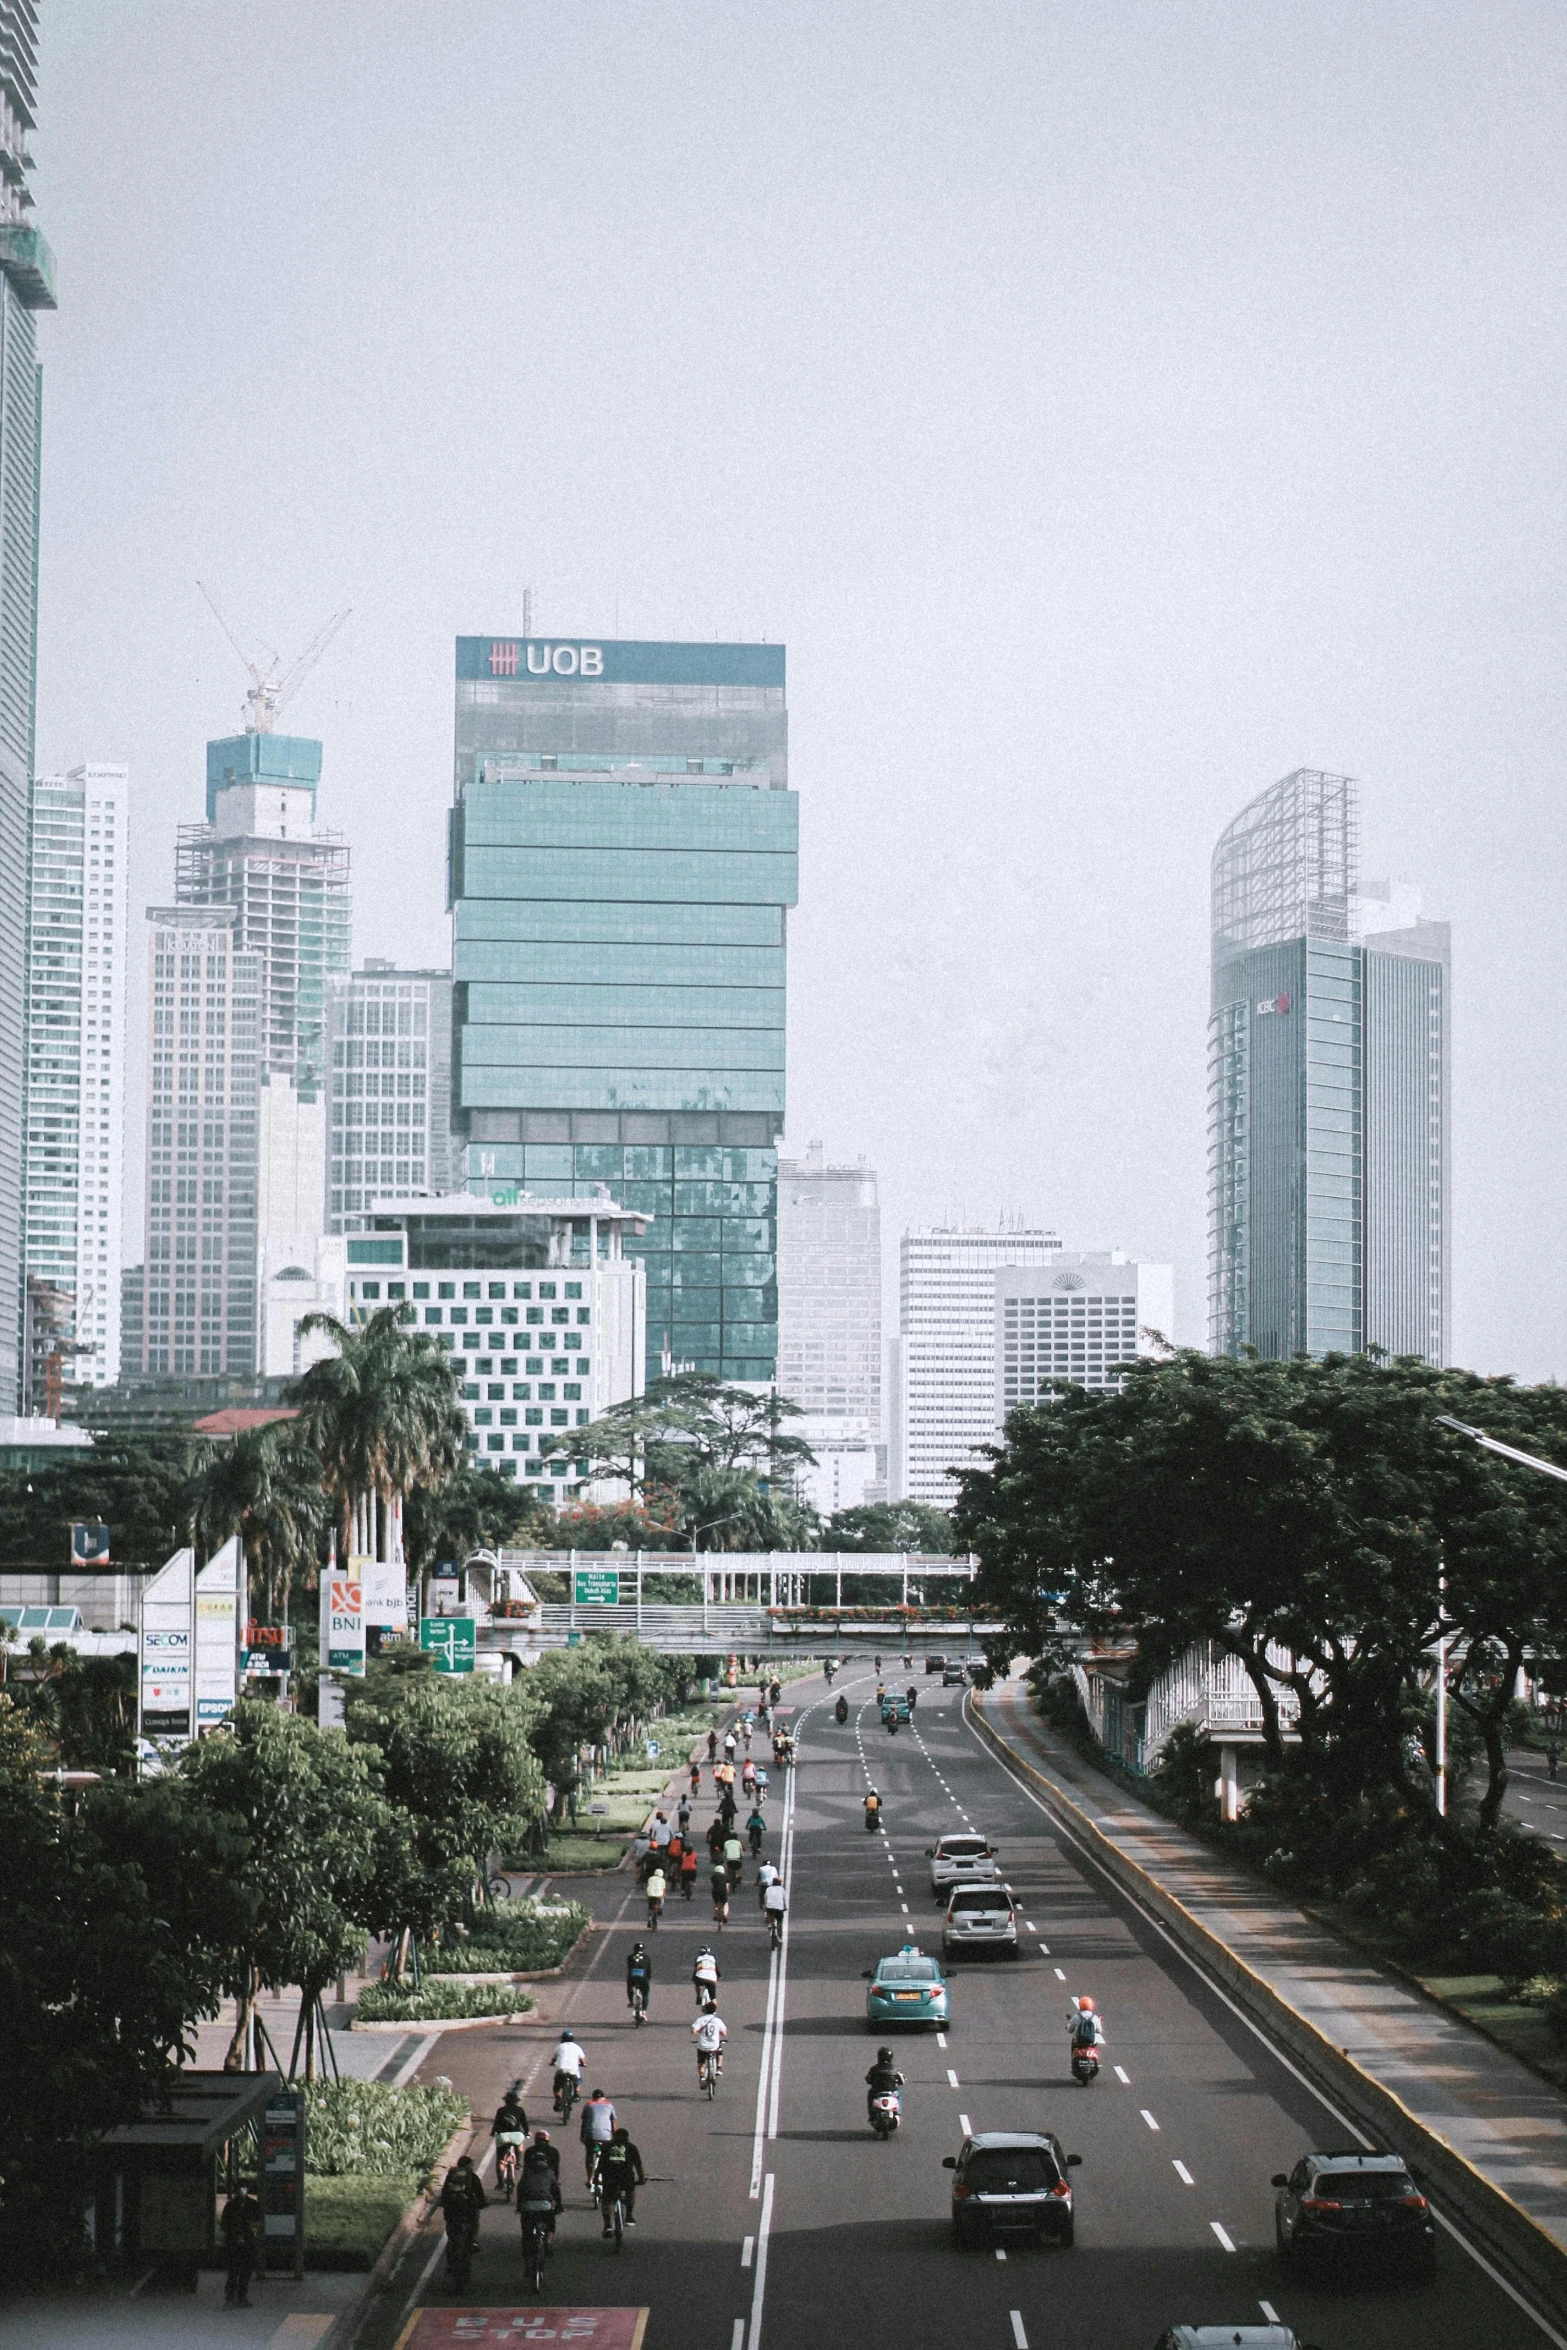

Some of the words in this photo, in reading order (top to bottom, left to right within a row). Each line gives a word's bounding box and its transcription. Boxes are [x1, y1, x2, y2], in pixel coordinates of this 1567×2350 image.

[526, 644, 604, 676] UOB
[167, 939, 215, 953] KERATON
[386, 1598, 404, 1608] bjb
[332, 1617, 361, 1630] BNI
[146, 1633, 188, 1646] SECOM
[379, 1632, 401, 1642] atm
[249, 1652, 266, 1661] ATM
[152, 1666, 189, 1674] DAIKIN
[199, 1702, 233, 1714] EPSON
[455, 2316, 598, 2328] BUS
[450, 2328, 595, 2340] STOP
